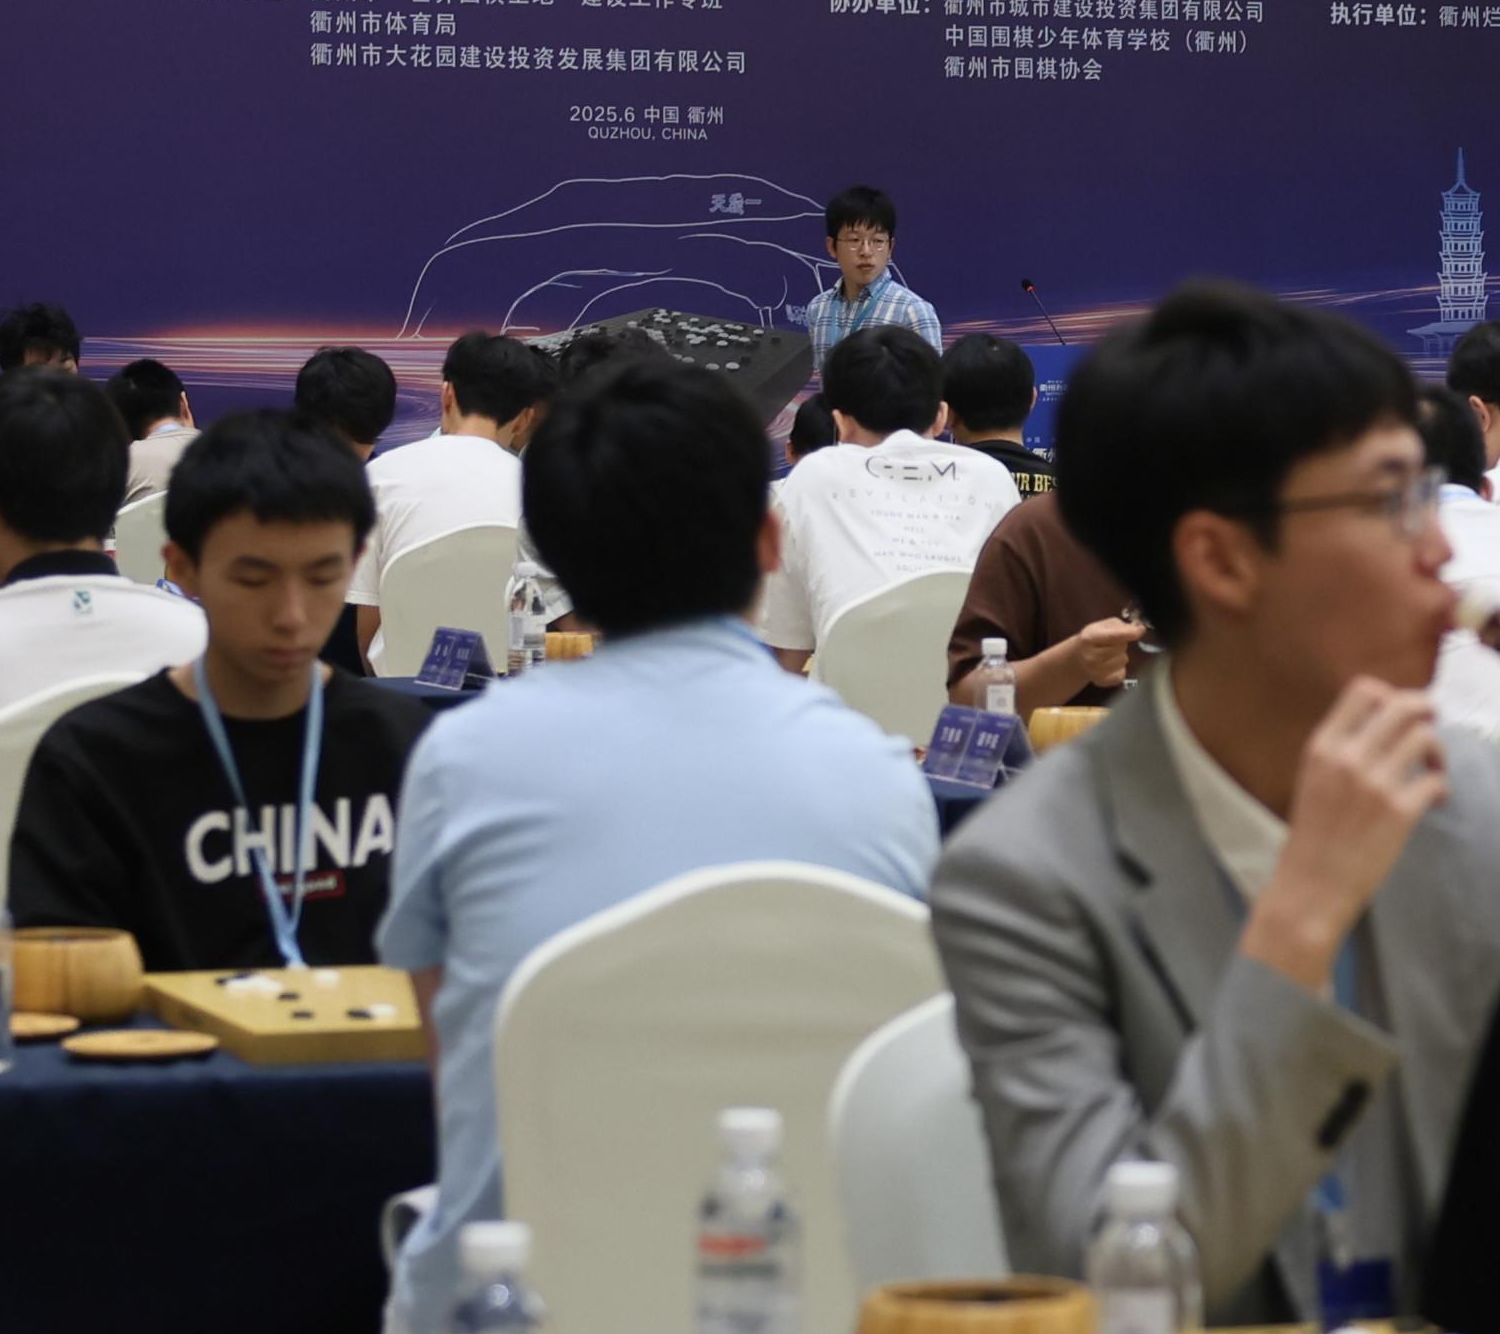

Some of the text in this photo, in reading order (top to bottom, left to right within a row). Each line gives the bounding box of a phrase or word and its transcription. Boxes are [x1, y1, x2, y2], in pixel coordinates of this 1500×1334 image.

[310, 10, 457, 36] 衢州市体育局
[310, 42, 746, 75] 衢州市大花园建设投资发展集团有限公司
[943, 55, 1103, 81] 衢州市围棋协会
[569, 104, 725, 126] 2025.6 中国 衢州
[588, 126, 708, 141] QUZHOU, CHINA
[184, 792, 396, 884] CHINA
